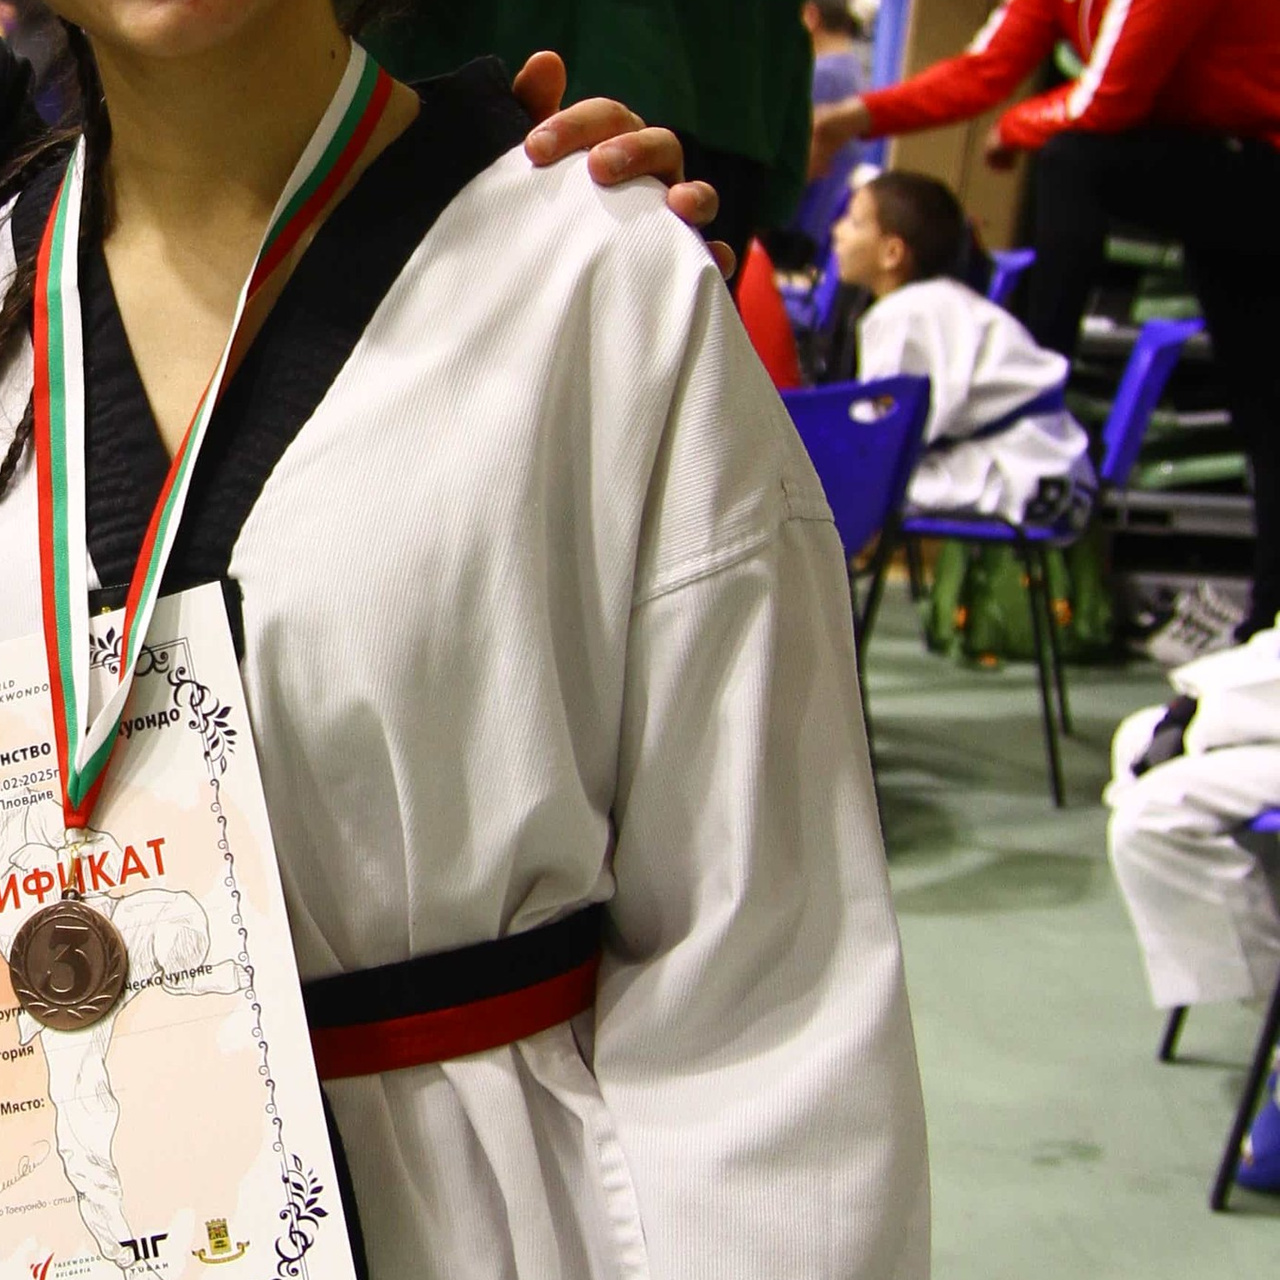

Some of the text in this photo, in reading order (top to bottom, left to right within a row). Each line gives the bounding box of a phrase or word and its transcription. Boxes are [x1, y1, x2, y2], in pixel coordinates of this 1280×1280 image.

[41, 924, 93, 1002] 3
[165, 964, 213, 985] чупене
[0, 1097, 46, 1116] Място:
